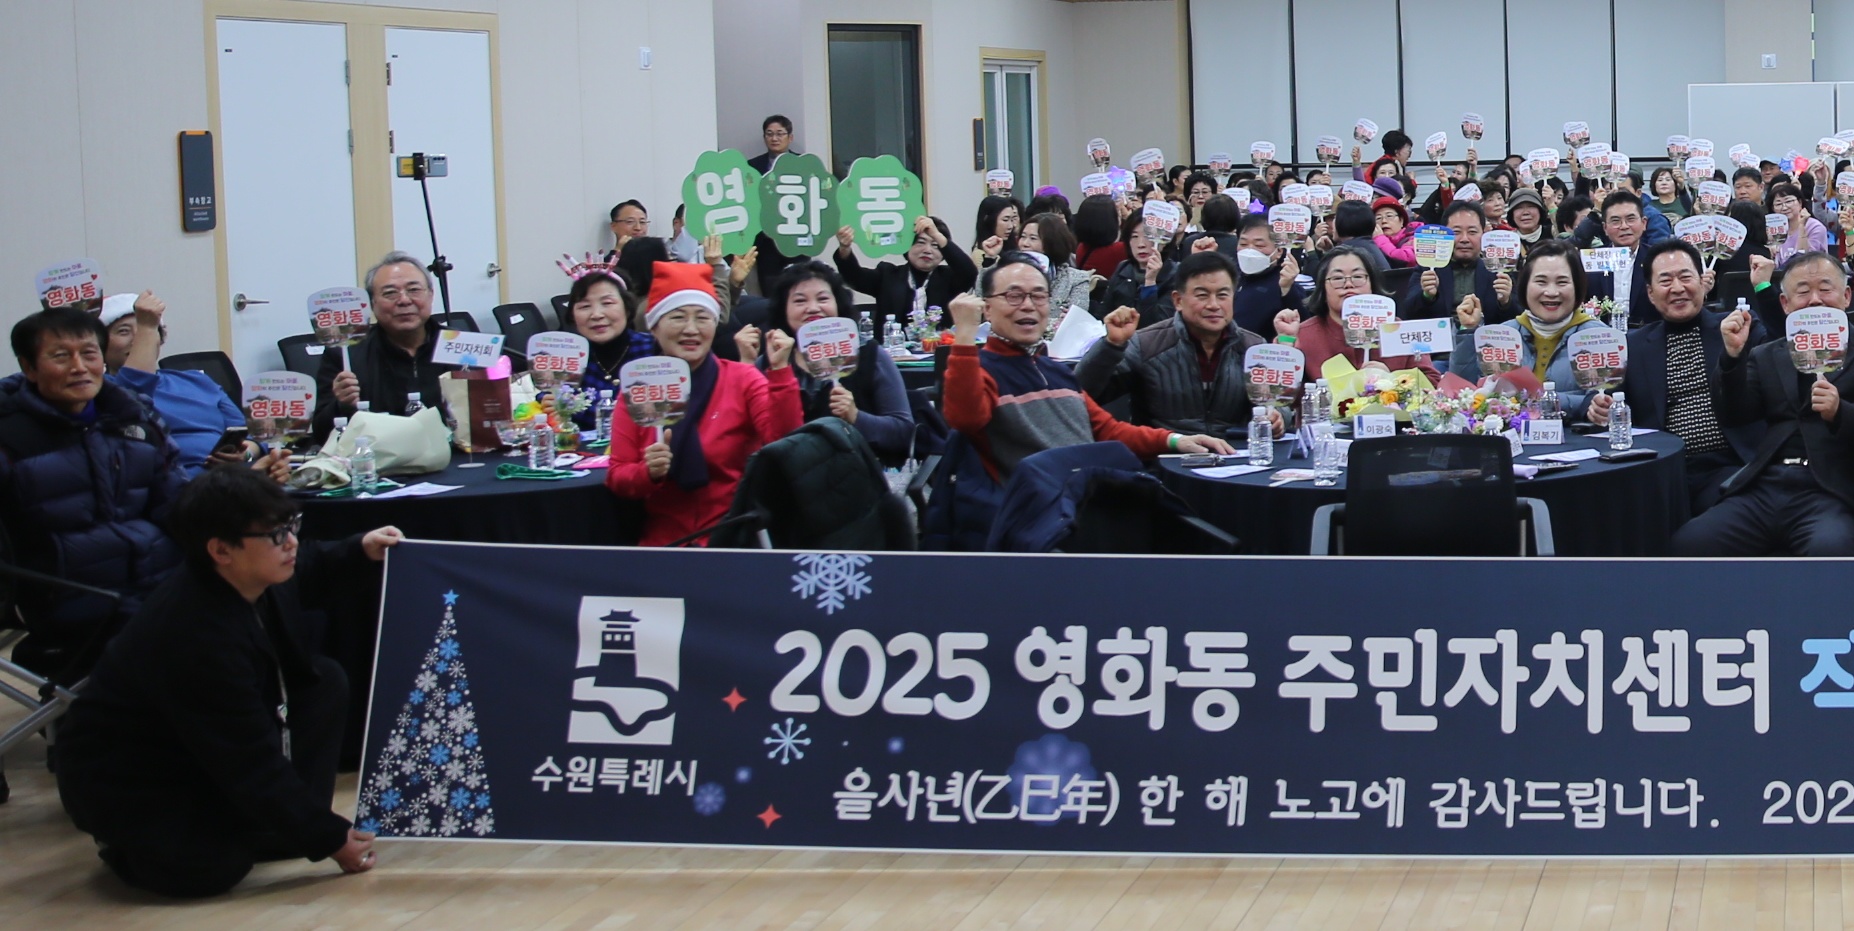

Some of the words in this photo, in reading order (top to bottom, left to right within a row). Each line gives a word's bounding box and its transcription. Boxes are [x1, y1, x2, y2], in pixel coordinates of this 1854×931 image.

[1274, 221, 1306, 233] 영화동
[1486, 248, 1515, 258] 영화동
[46, 281, 96, 308] 영화동
[316, 309, 364, 327] 영화동
[1400, 331, 1433, 344] 단체장
[1794, 333, 1840, 351] 영화동
[444, 340, 494, 356] 주민자치회
[807, 340, 852, 360] 영화동
[1482, 348, 1517, 363] 영화동
[534, 354, 580, 371] 영화동
[1576, 352, 1620, 370] 영화동
[1251, 367, 1295, 386] 영화동
[630, 383, 682, 403] 영화동
[251, 399, 306, 419] 영화동
[770, 629, 990, 720] 2025
[1015, 626, 1256, 731] 영화동
[1278, 629, 1769, 734] 주민자치센터
[532, 757, 698, 796] 수원특례시
[1139, 775, 1184, 825] 한
[1205, 776, 1248, 826] 해
[1270, 777, 1405, 828] 노고에
[1429, 778, 1719, 828] 감사드립니다.
